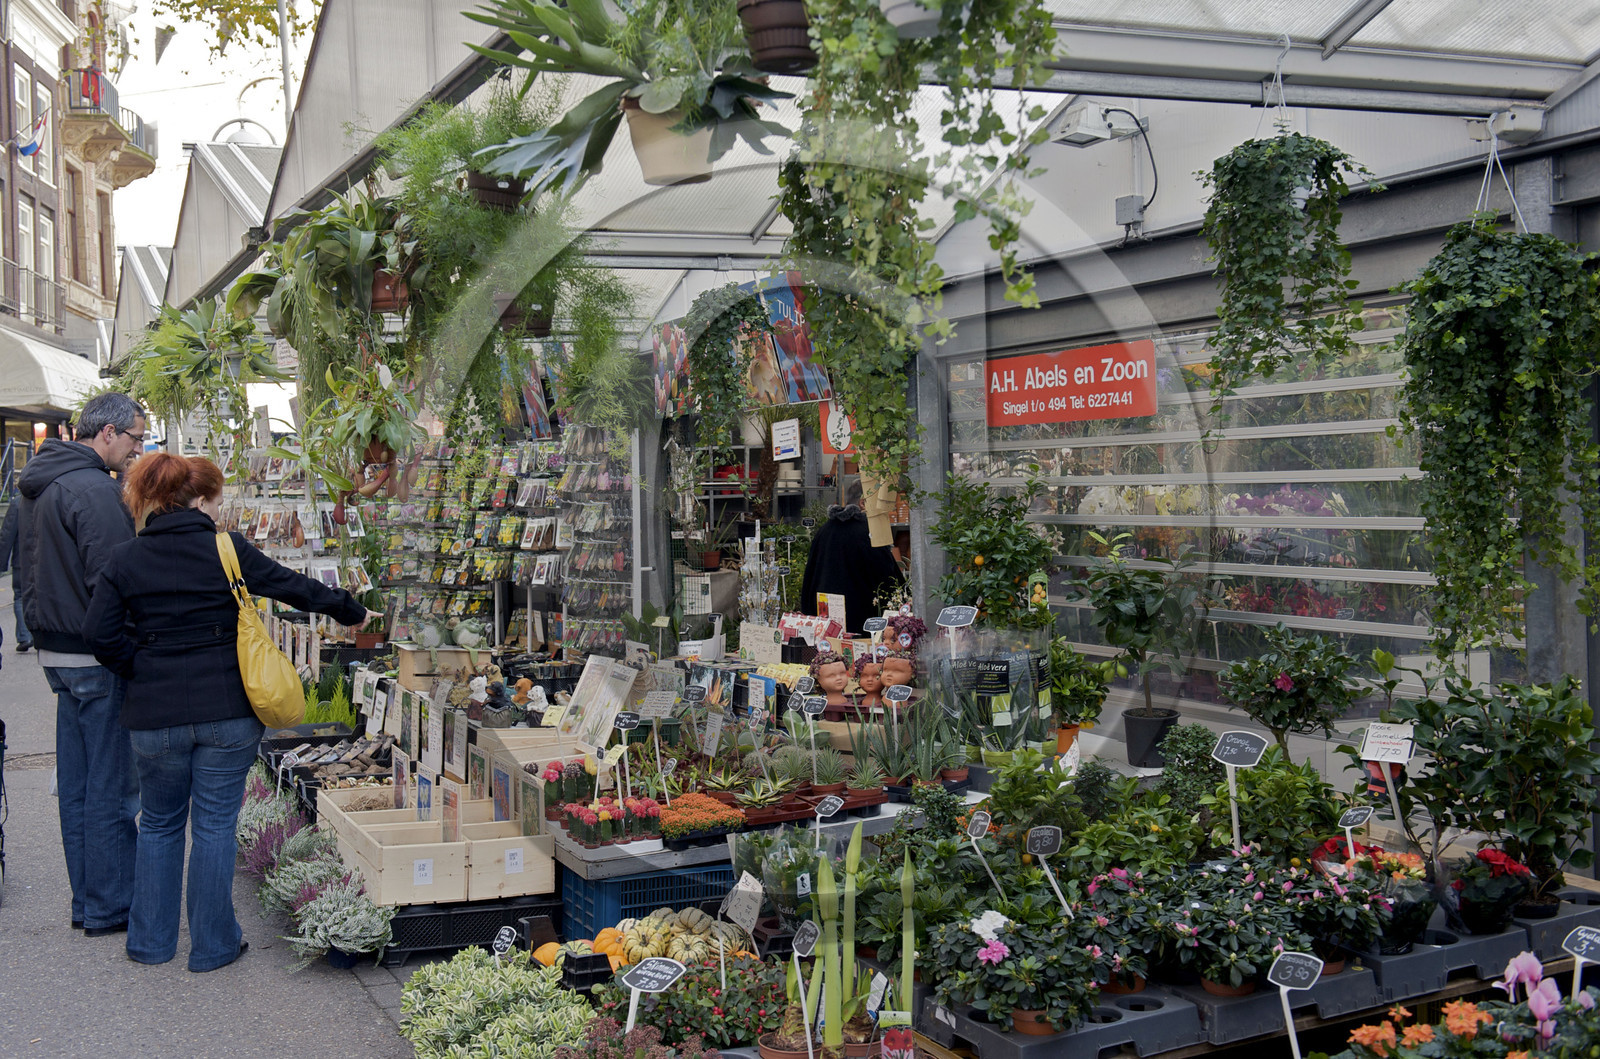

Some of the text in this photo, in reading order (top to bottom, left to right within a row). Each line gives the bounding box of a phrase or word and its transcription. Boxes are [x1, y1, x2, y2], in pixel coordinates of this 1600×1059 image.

[990, 357, 1148, 393] A.H. Abels en Zoon
[1003, 390, 1133, 416] Singel t/o 494 Tel: 6227441
